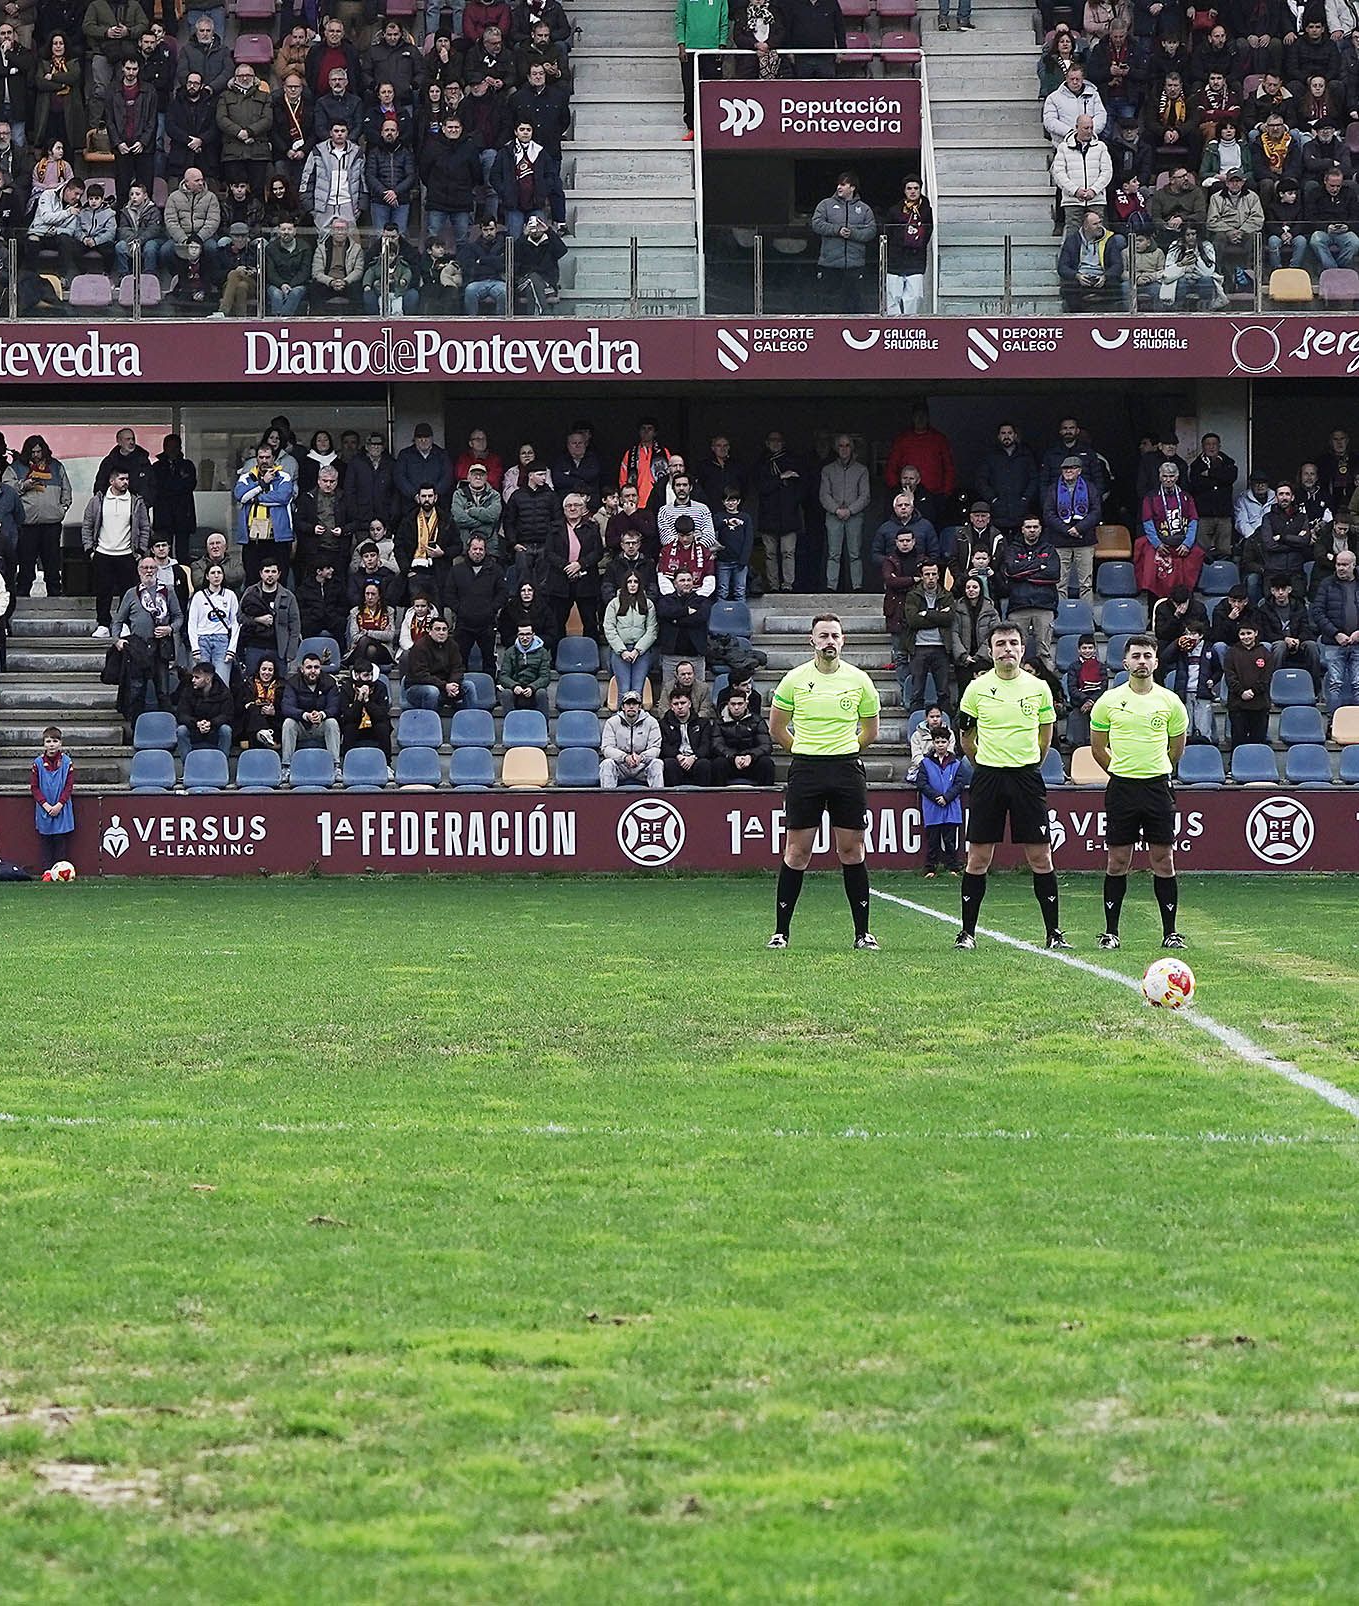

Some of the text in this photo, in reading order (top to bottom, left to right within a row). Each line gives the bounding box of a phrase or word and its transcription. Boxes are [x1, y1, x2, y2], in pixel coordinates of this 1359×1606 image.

[781, 96, 901, 118] Deputación
[781, 117, 901, 133] Pontevedra
[753, 328, 814, 339] DEPORTE
[884, 329, 927, 338] GALICIA
[1002, 328, 1063, 338] DEPORTE
[1133, 329, 1176, 338] GALICIA
[753, 341, 808, 352] GALEGO
[884, 339, 939, 349] SAUDABLE
[1002, 340, 1057, 351] GALEGO
[1133, 339, 1188, 348] SAUDABLE
[132, 815, 267, 842] VERSUS
[362, 804, 576, 857] FEDERACIÓN
[149, 843, 254, 857] E-LEARNING
